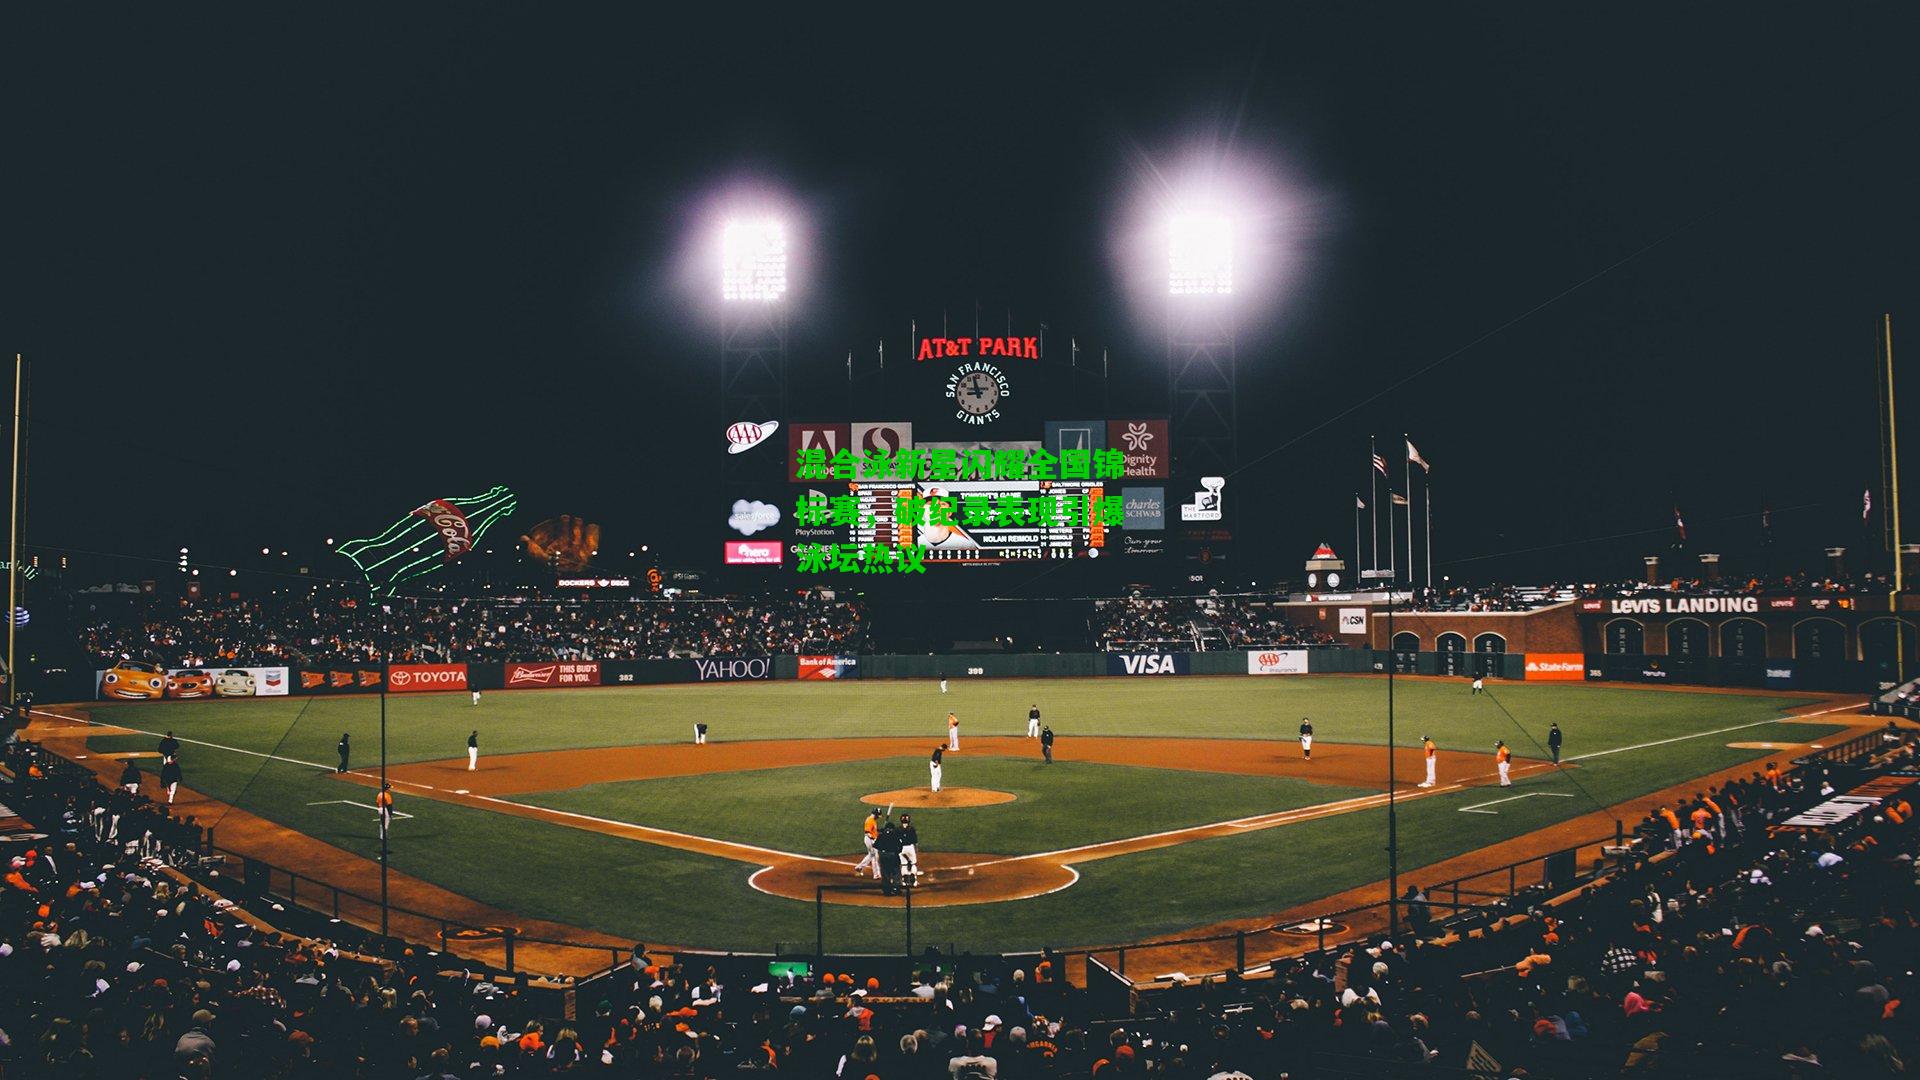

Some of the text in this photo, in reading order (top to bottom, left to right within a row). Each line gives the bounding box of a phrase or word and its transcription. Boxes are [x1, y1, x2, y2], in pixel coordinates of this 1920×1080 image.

[918, 337, 1038, 361] AT&T PARK
[946, 362, 1010, 398] SAN FRANCISCO
[956, 409, 1000, 425] GIANTS
[728, 425, 762, 444] AAA
[1122, 467, 1156, 476] Health
[1126, 499, 1161, 510] charles
[735, 511, 776, 521] salesforce
[1126, 510, 1161, 518] SCHWAB
[795, 529, 835, 537] PlayStation
[1125, 536, 1162, 547] Own your
[1666, 597, 1759, 613] LANDING
[1350, 616, 1364, 625] CSN
[800, 658, 818, 666] Bank
[827, 658, 856, 666] America
[1119, 655, 1176, 674] VISA
[560, 665, 598, 673] THIS BUD'S
[695, 658, 770, 681] YAHOO!
[413, 671, 467, 683] TOYOTA
[560, 674, 590, 682] FOR YOU.
